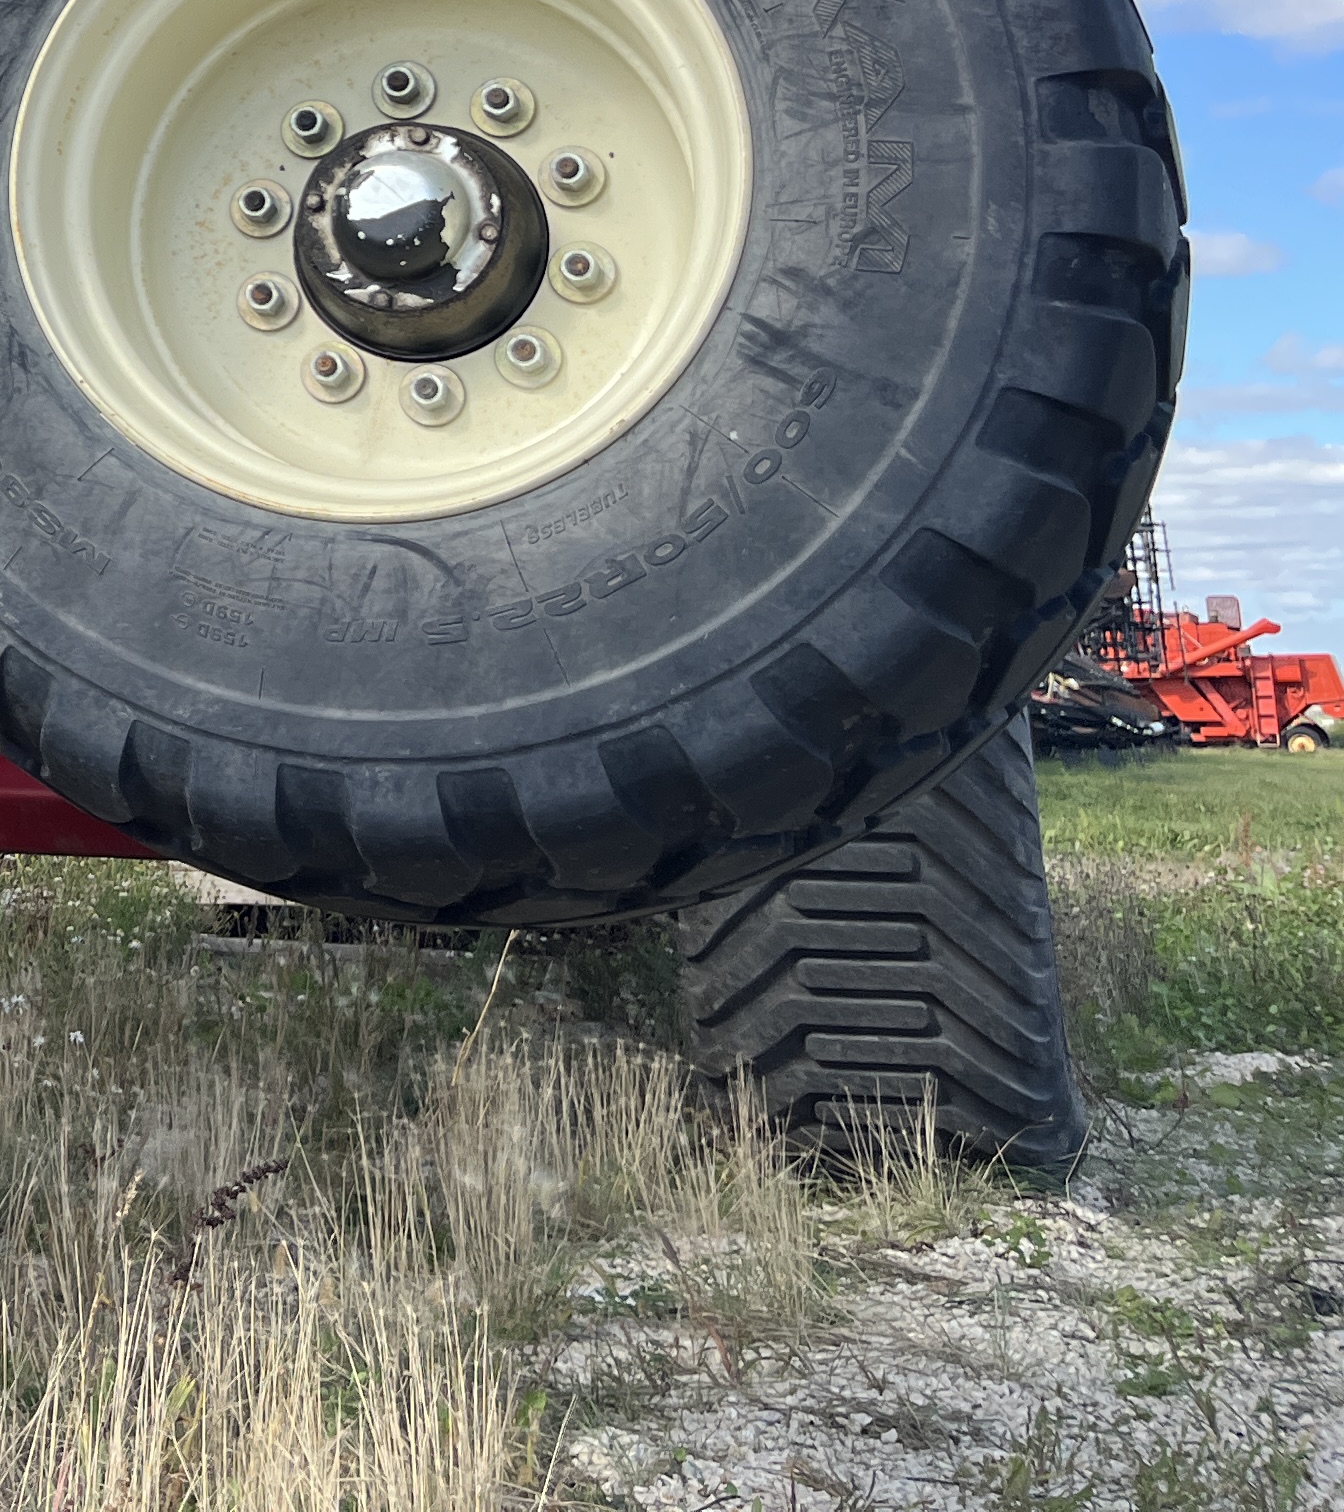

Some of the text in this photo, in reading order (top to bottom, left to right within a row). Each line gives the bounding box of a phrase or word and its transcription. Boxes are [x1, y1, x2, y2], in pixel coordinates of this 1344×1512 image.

[829, 48, 860, 268] ENGINEERED IN EUROPE
[421, 366, 838, 646] 600/50R22.5
[524, 482, 629, 546] TUBELESS
